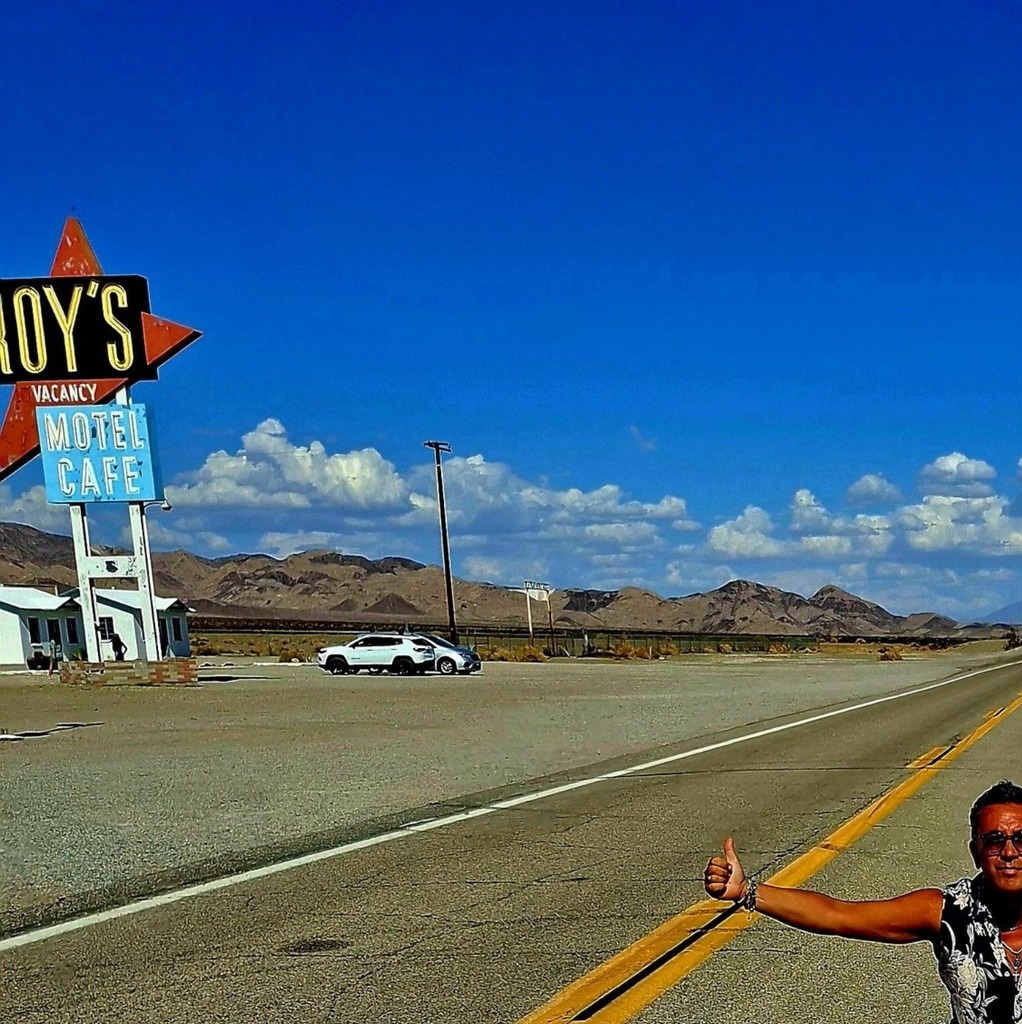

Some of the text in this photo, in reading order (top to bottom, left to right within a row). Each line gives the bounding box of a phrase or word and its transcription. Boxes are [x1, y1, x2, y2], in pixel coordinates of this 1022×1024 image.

[31, 384, 97, 403] VACANCY
[43, 411, 146, 452] MOTEL
[57, 456, 140, 496] CAFE
